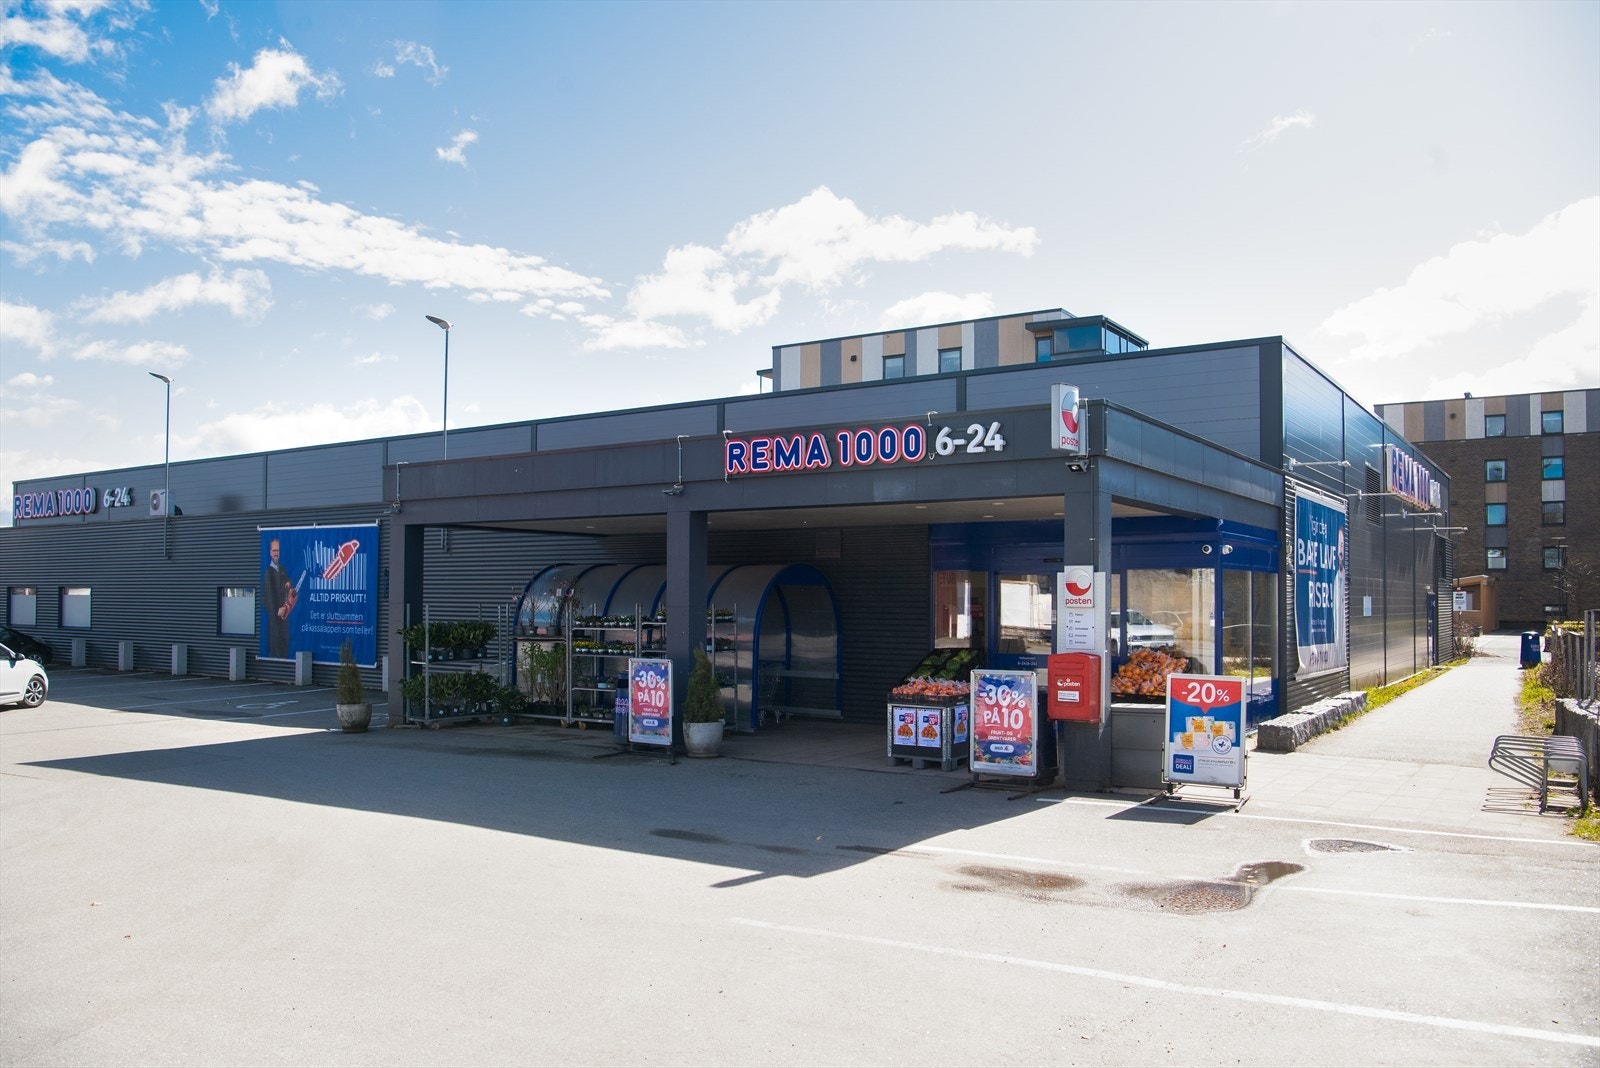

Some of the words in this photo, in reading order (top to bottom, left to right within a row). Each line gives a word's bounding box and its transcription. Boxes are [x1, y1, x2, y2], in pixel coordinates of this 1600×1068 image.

[725, 433, 831, 474] REMA
[835, 422, 926, 467] 1000
[936, 421, 1006, 456] 6-24
[13, 491, 54, 519] REMA
[58, 486, 93, 516] 1000
[103, 486, 129, 508] 6-24
[311, 593, 329, 602] ALLTID
[330, 593, 367, 603] PRISKUTT!
[1065, 598, 1092, 606] posten
[635, 670, 665, 690] -30%
[638, 690, 651, 703] PÅ
[650, 690, 665, 708] 10
[979, 684, 1026, 708] -30%
[1181, 682, 1230, 704] -20%
[983, 707, 1000, 724] PÅ
[1001, 707, 1024, 730] 10
[1175, 763, 1192, 771] DEAL!
